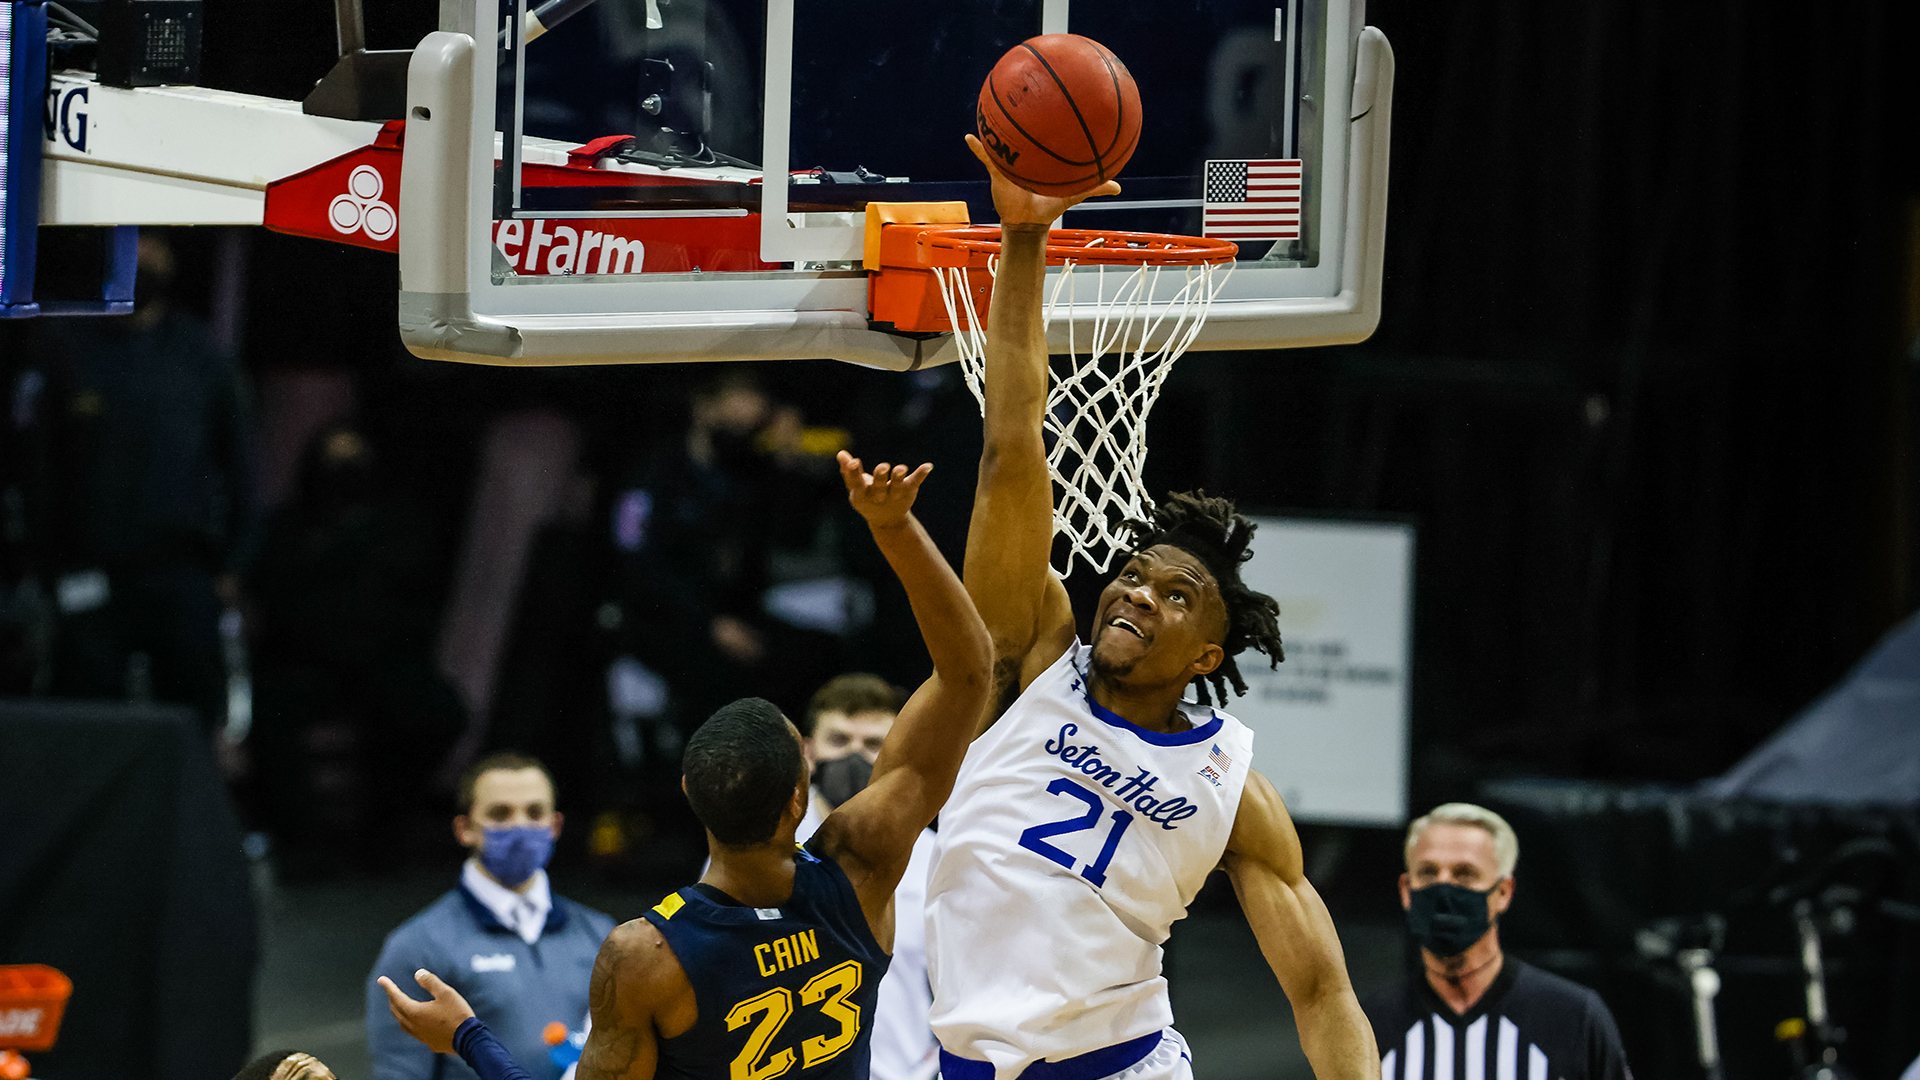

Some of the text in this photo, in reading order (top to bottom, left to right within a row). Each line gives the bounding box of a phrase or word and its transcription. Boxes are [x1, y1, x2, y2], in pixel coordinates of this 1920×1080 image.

[1044, 723, 1198, 830] Seton Hall
[1200, 768, 1222, 787] EAST
[1204, 765, 1220, 779] BIG
[1018, 777, 1134, 889] 21
[753, 928, 821, 978] CAIN
[724, 959, 863, 1080] 23
